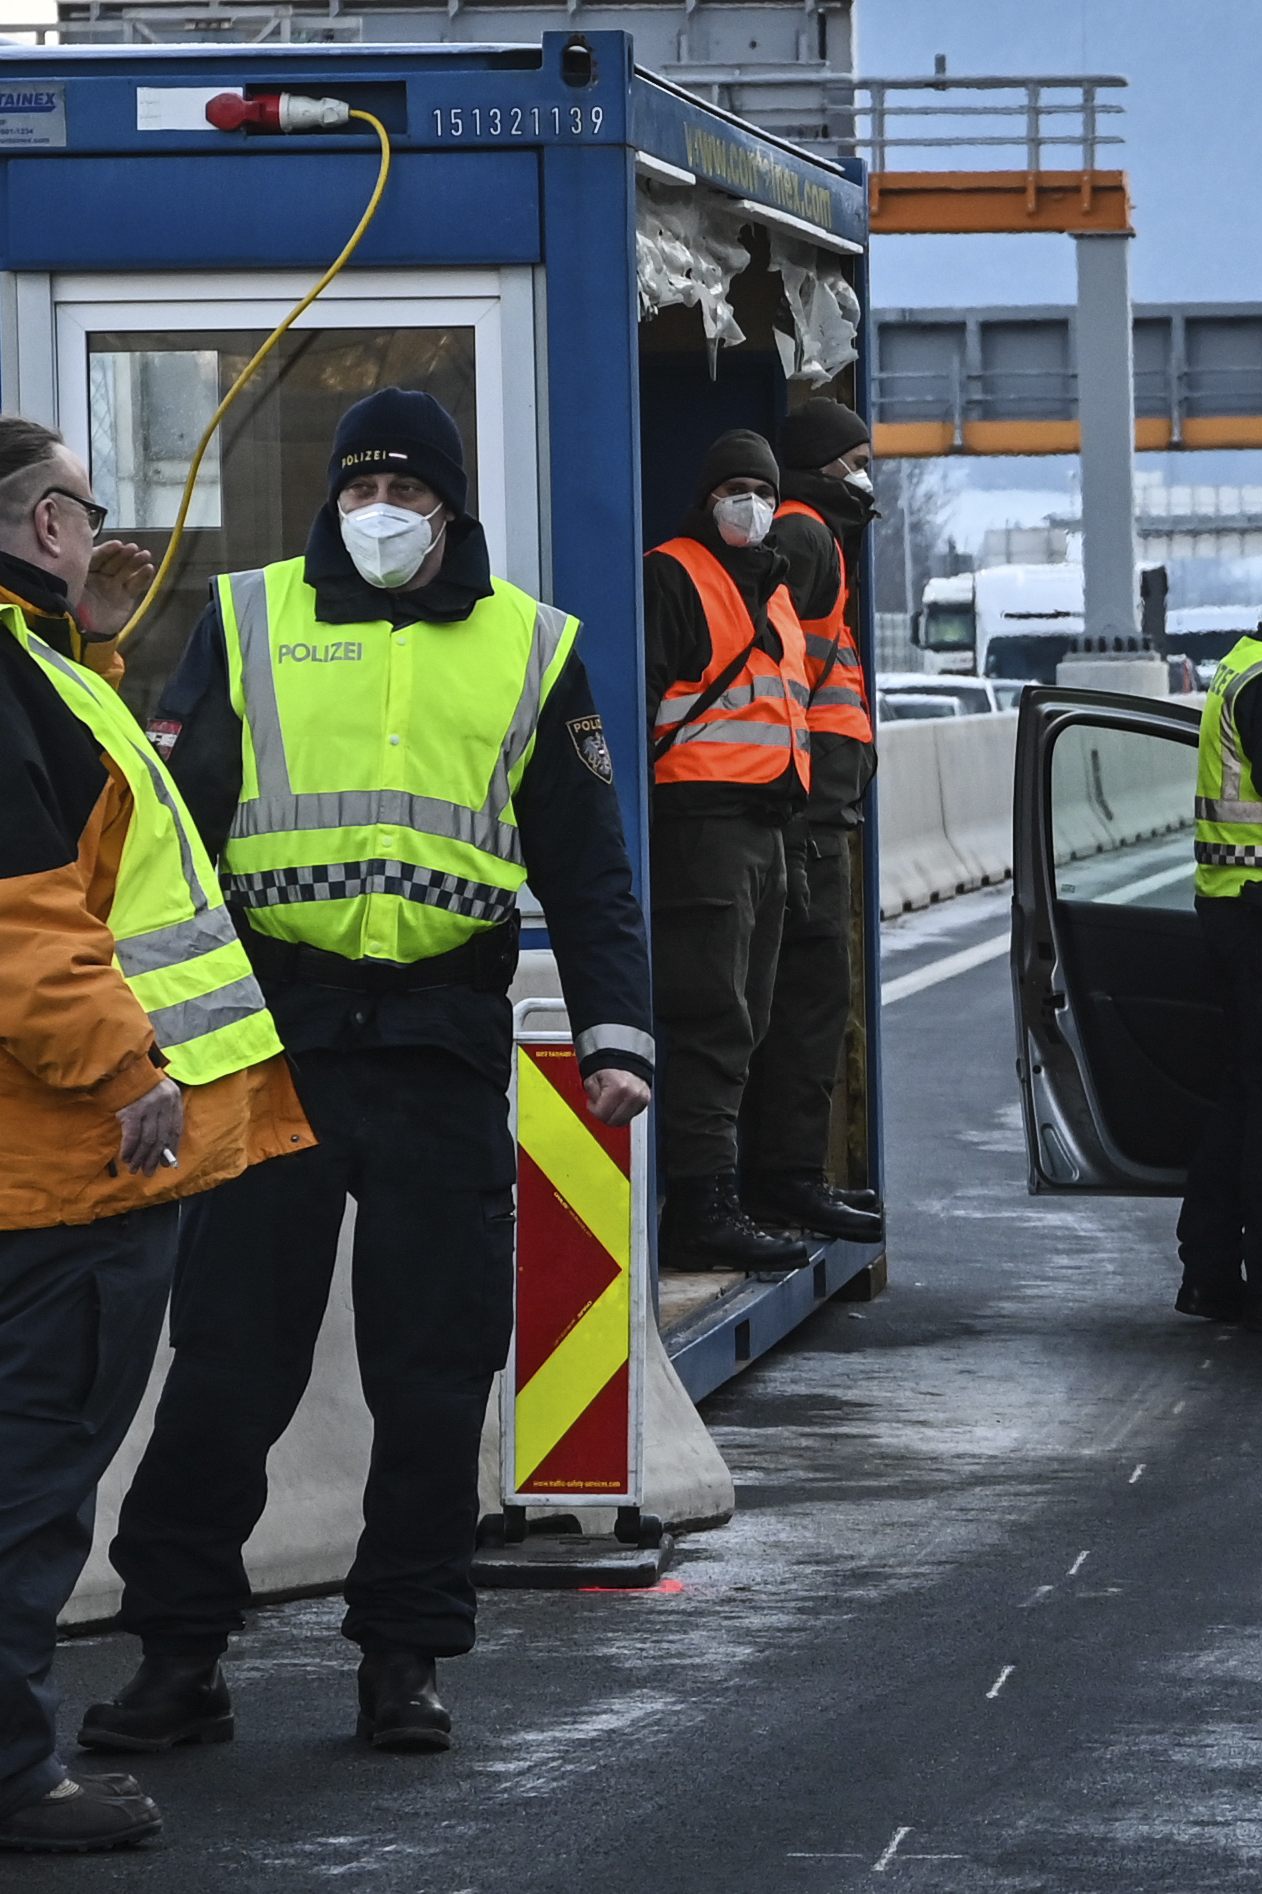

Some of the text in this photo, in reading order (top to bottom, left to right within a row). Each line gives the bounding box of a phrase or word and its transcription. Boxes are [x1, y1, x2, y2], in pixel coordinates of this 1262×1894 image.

[0, 92, 57, 106] TAINEX
[433, 106, 603, 137] 151321139
[341, 450, 387, 469] POLIZEI
[278, 641, 362, 664] POLIZEI
